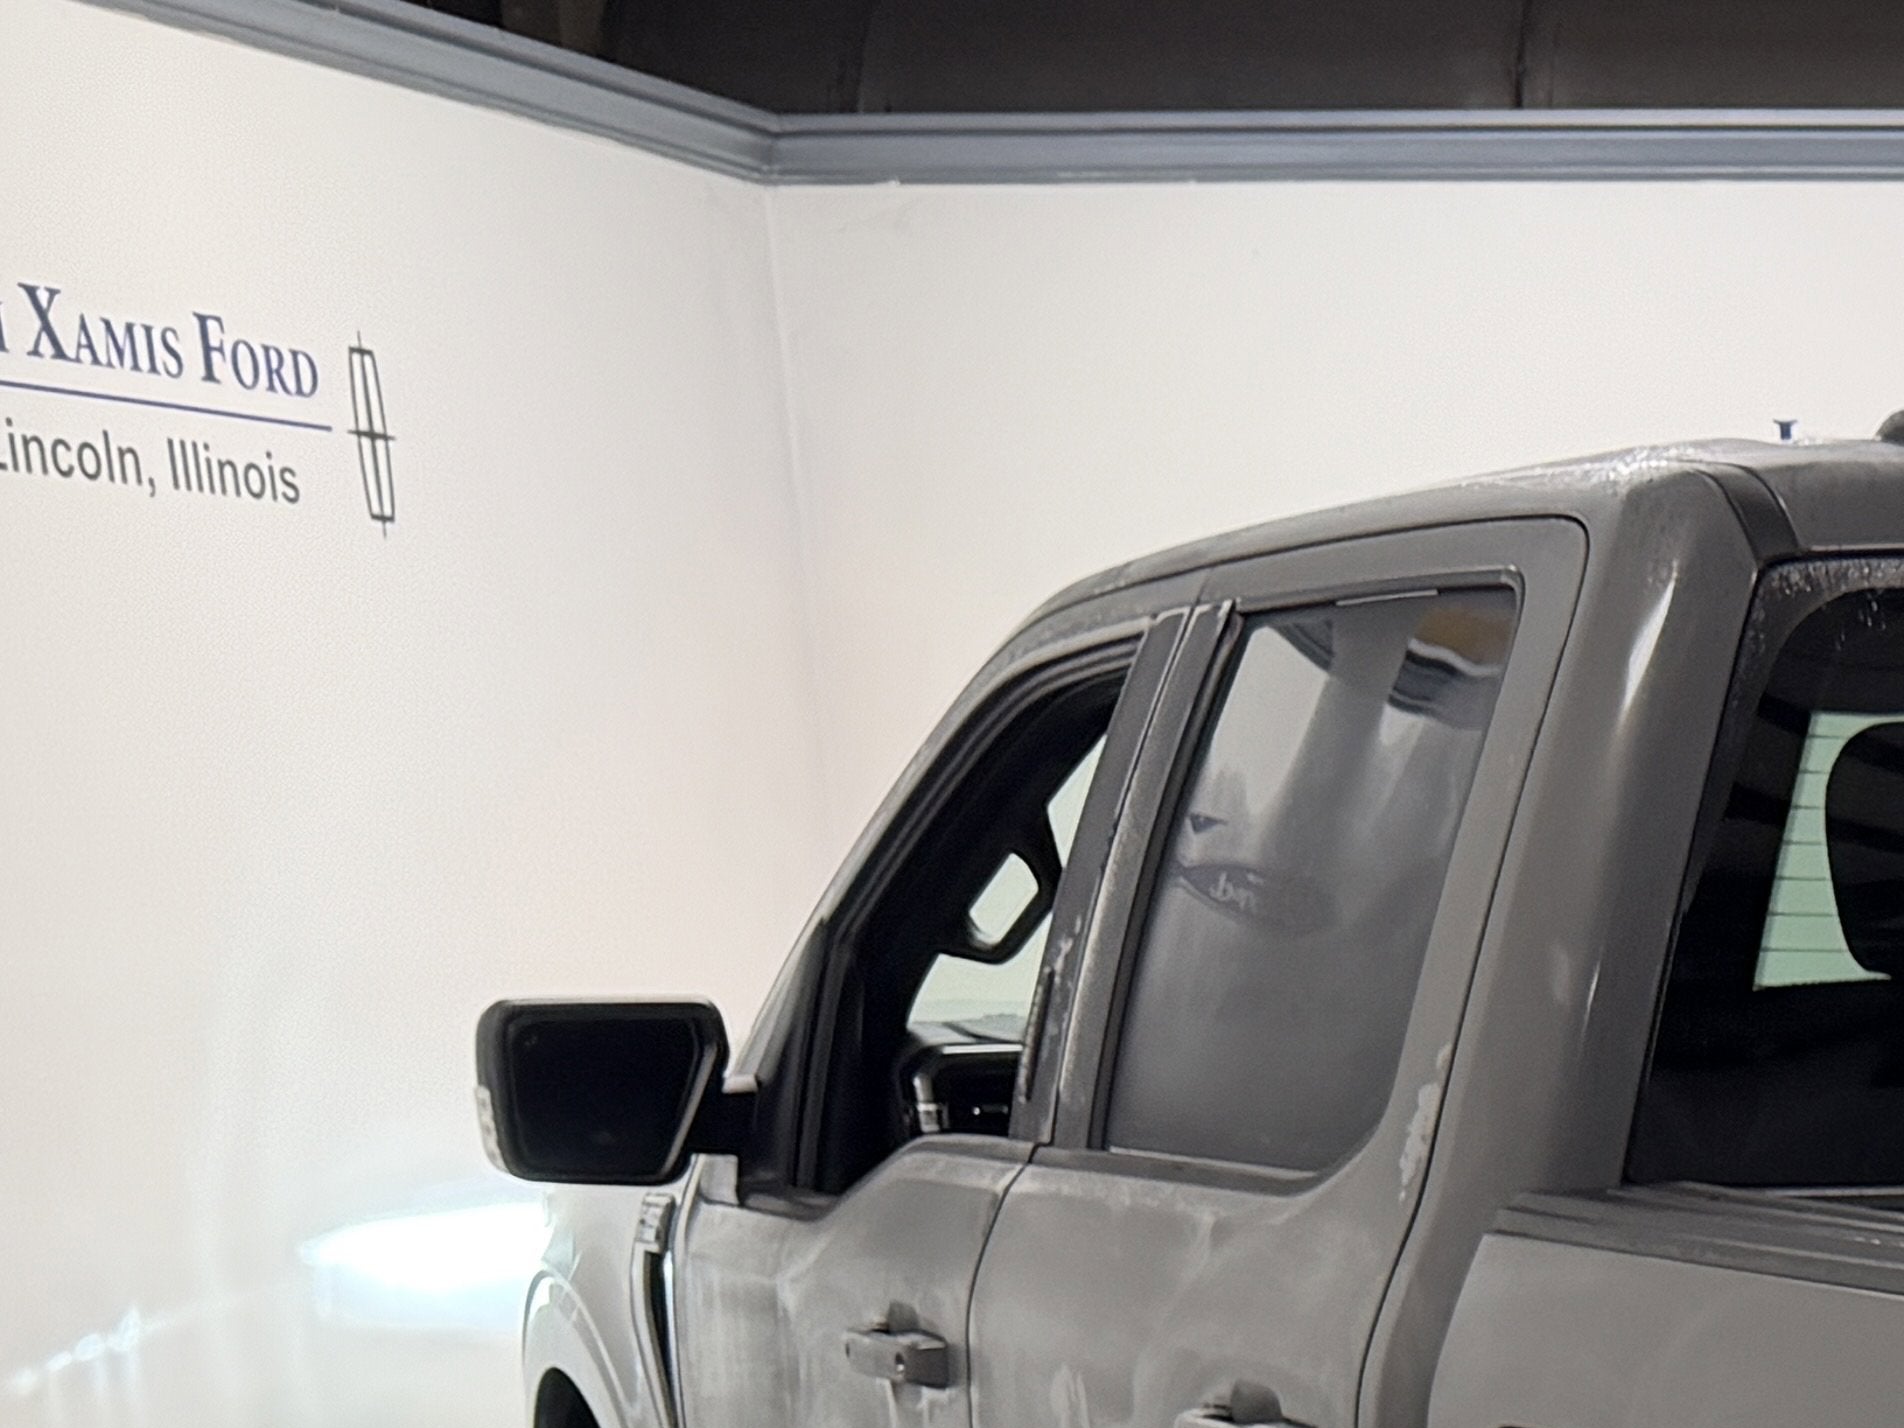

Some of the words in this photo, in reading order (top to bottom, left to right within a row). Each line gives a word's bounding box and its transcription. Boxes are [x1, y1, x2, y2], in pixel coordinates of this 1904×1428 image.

[17, 282, 184, 380] XAMIS
[192, 311, 319, 398] FORD
[166, 437, 301, 504] Illinois
